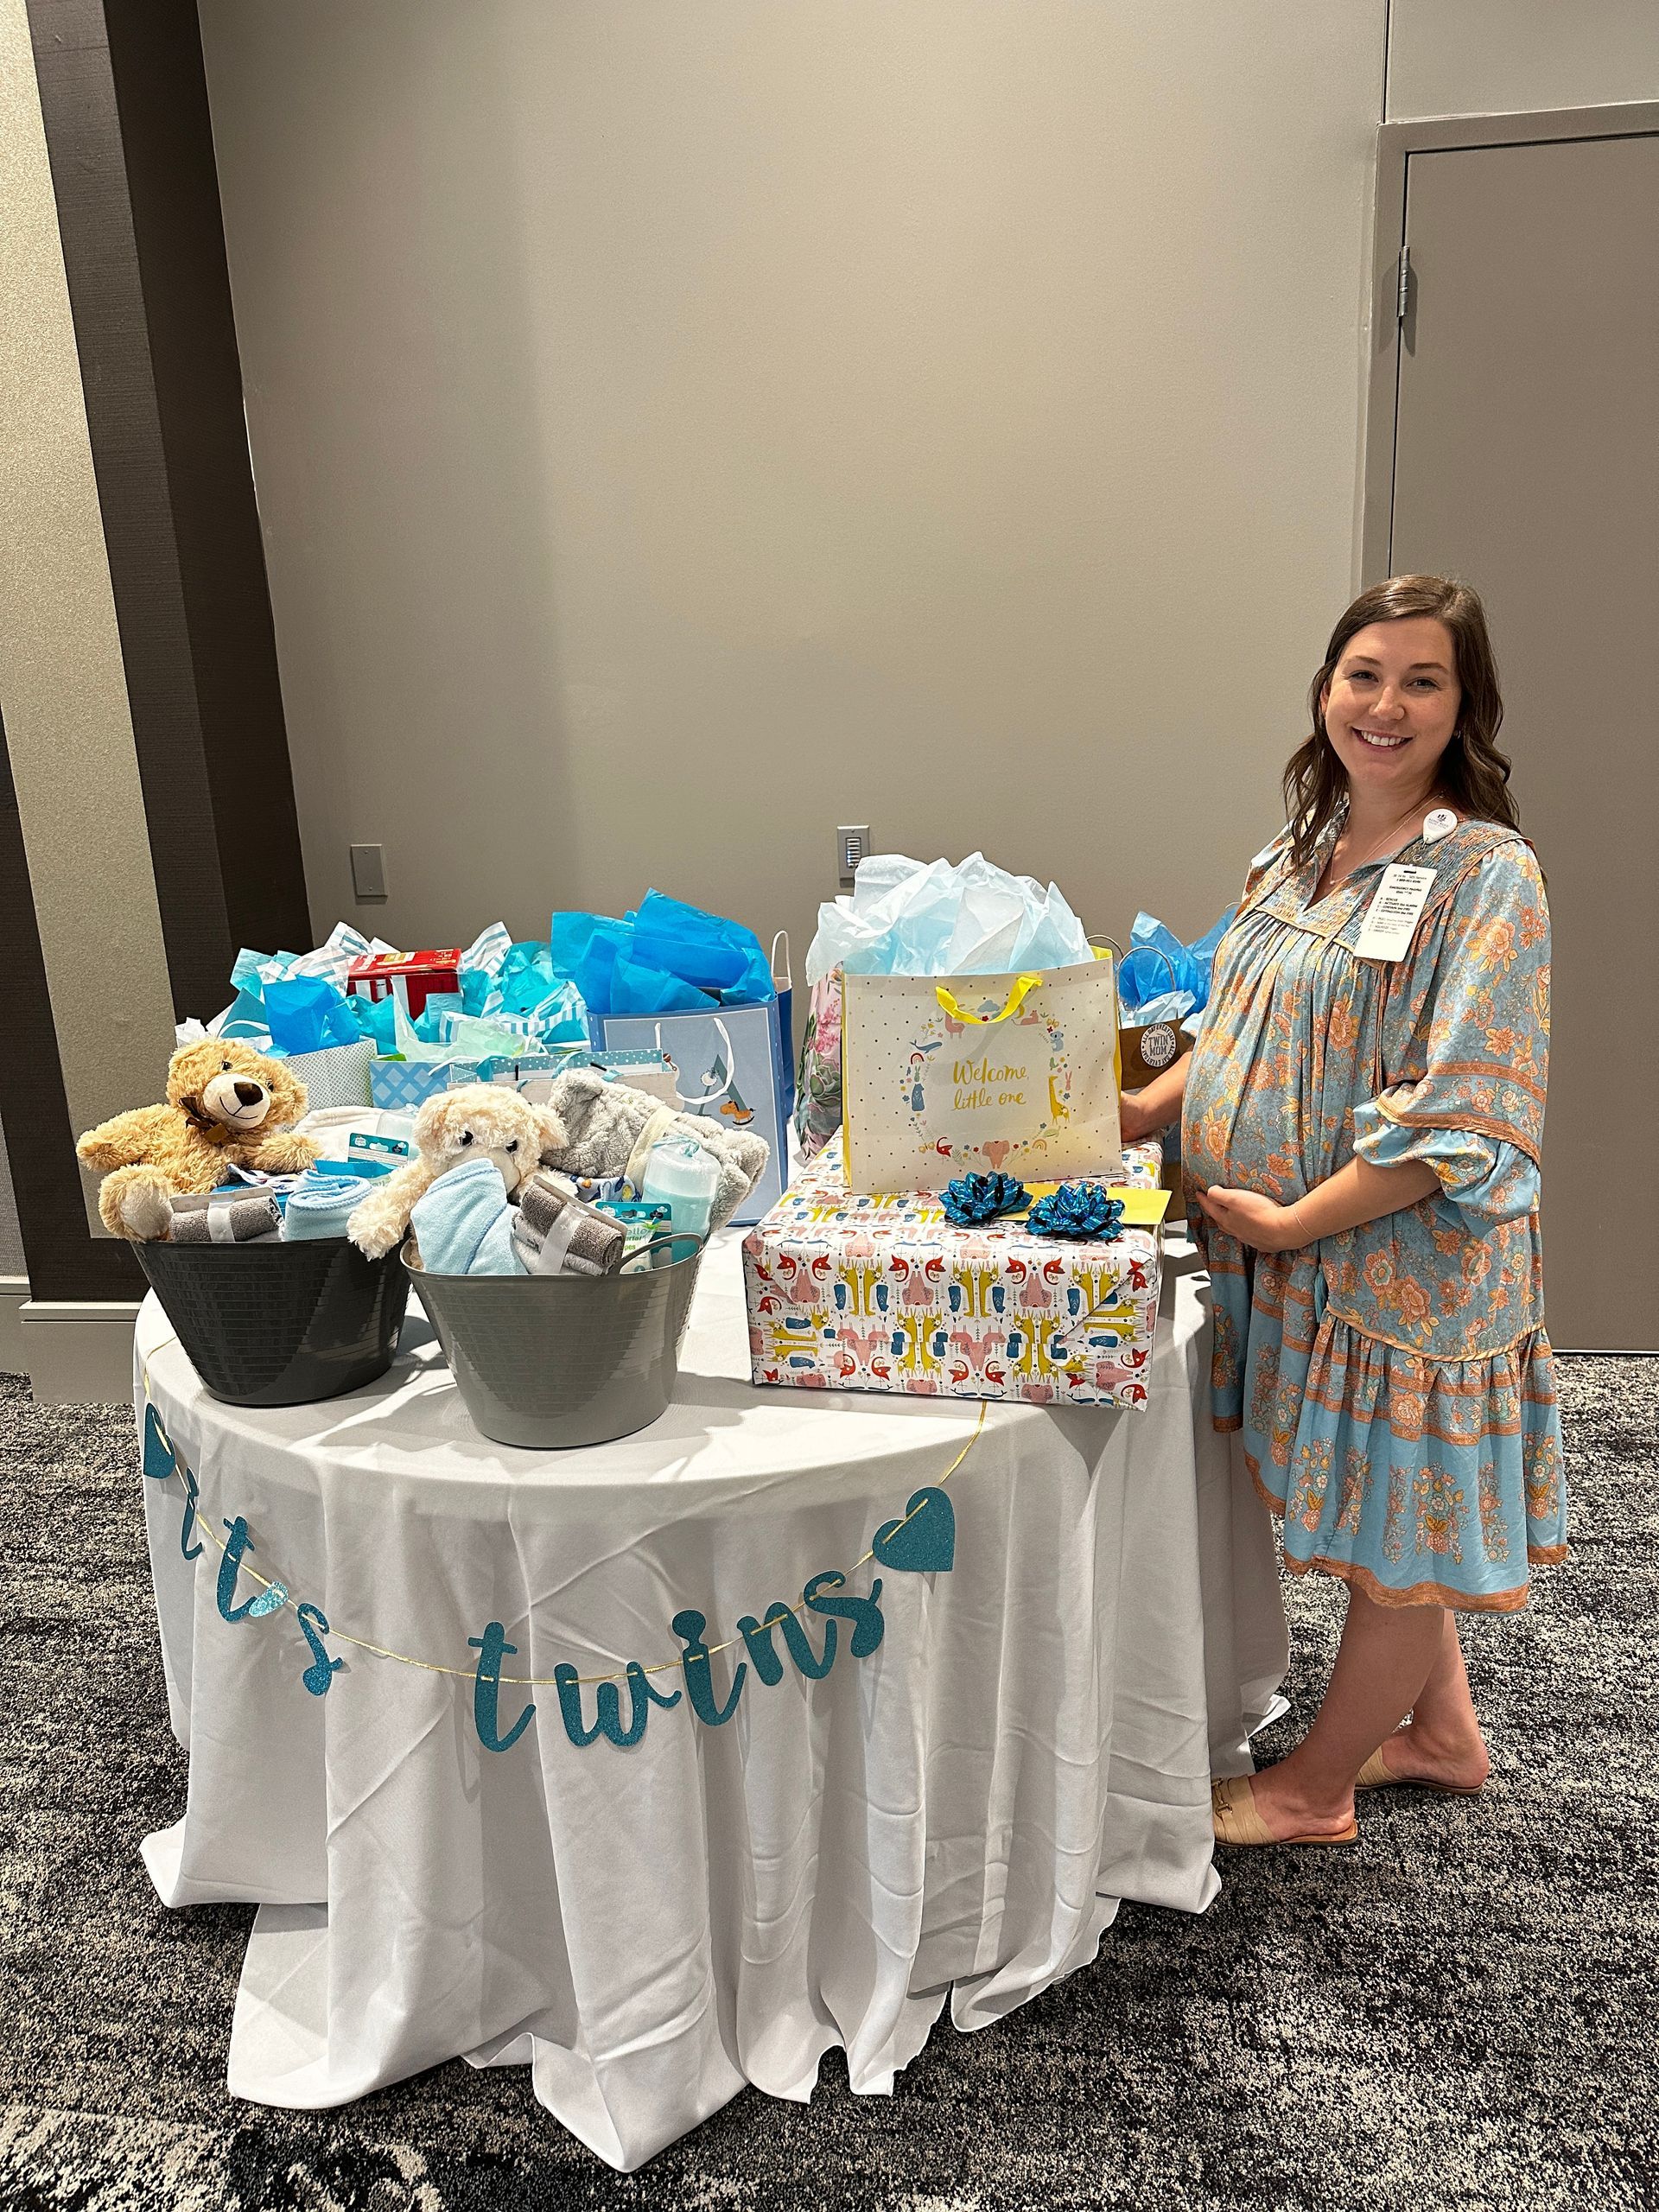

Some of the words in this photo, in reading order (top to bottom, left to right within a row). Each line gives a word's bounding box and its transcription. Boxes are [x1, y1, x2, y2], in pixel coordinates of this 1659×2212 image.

[1148, 1035, 1168, 1046] TWIN
[1149, 1046, 1167, 1057] MOM
[951, 1088, 993, 1111] little
[998, 1092, 1027, 1105] one
[467, 1569, 885, 1753] twins
